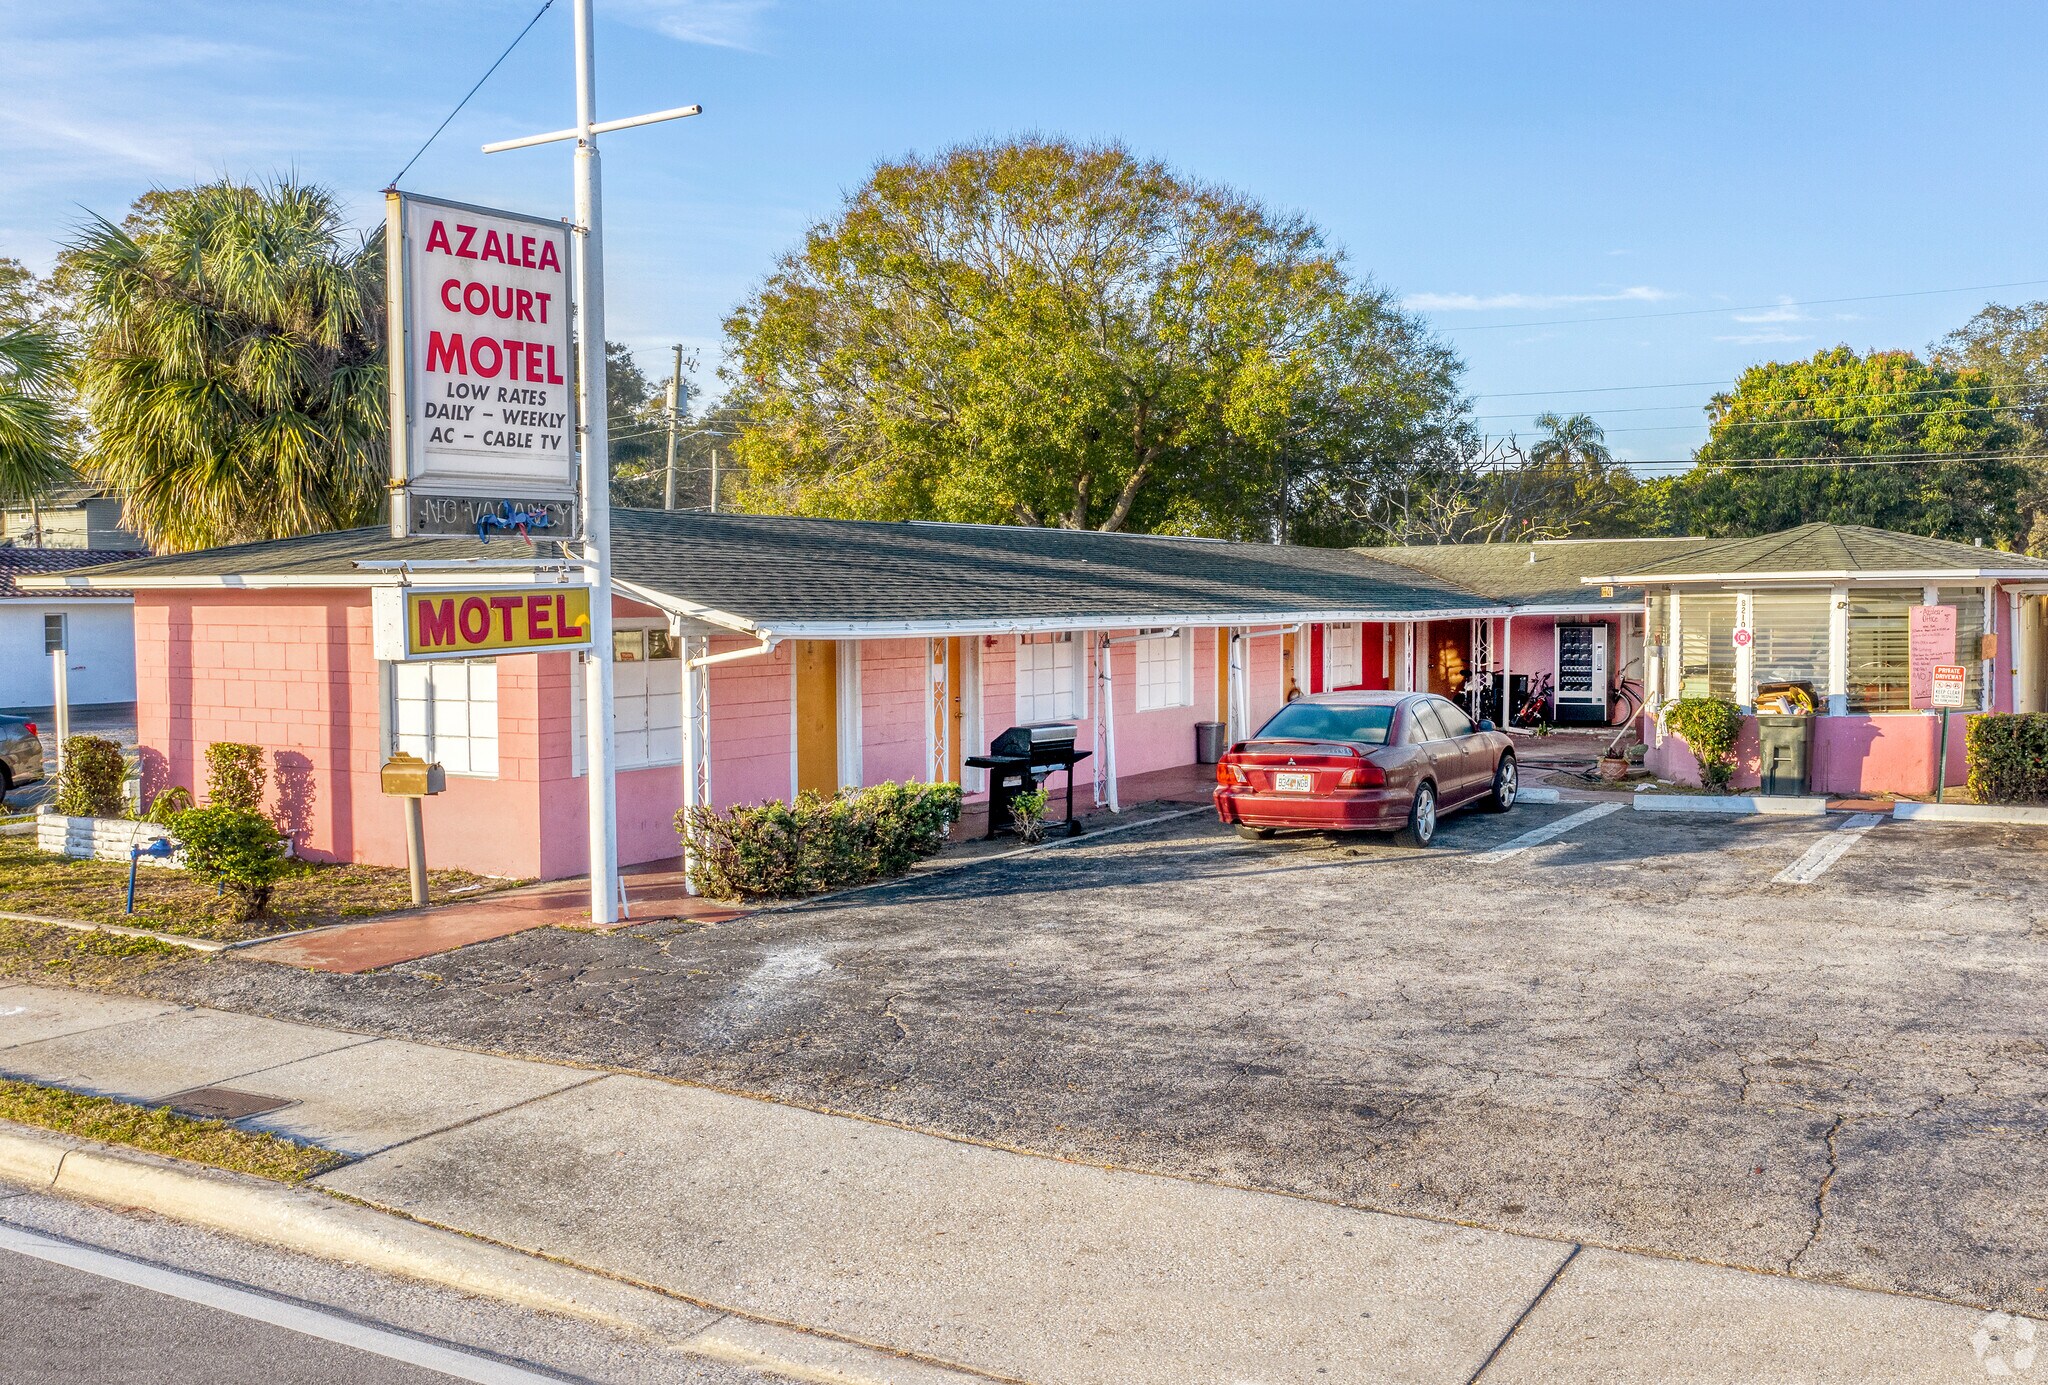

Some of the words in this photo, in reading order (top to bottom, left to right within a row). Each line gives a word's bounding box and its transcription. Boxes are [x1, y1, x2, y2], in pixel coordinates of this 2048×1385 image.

[425, 220, 562, 274] AZALEA
[441, 279, 552, 324] COURT
[426, 331, 564, 385] MOTEL
[447, 382, 490, 401] LOW
[497, 385, 547, 406] RATES
[425, 402, 475, 421] DAILY
[502, 408, 566, 429] WEEKLY
[430, 427, 455, 444] AC
[483, 430, 532, 449] CABLE
[541, 434, 562, 451] TV
[425, 499, 457, 524] NO
[418, 594, 583, 647] MOTEL
